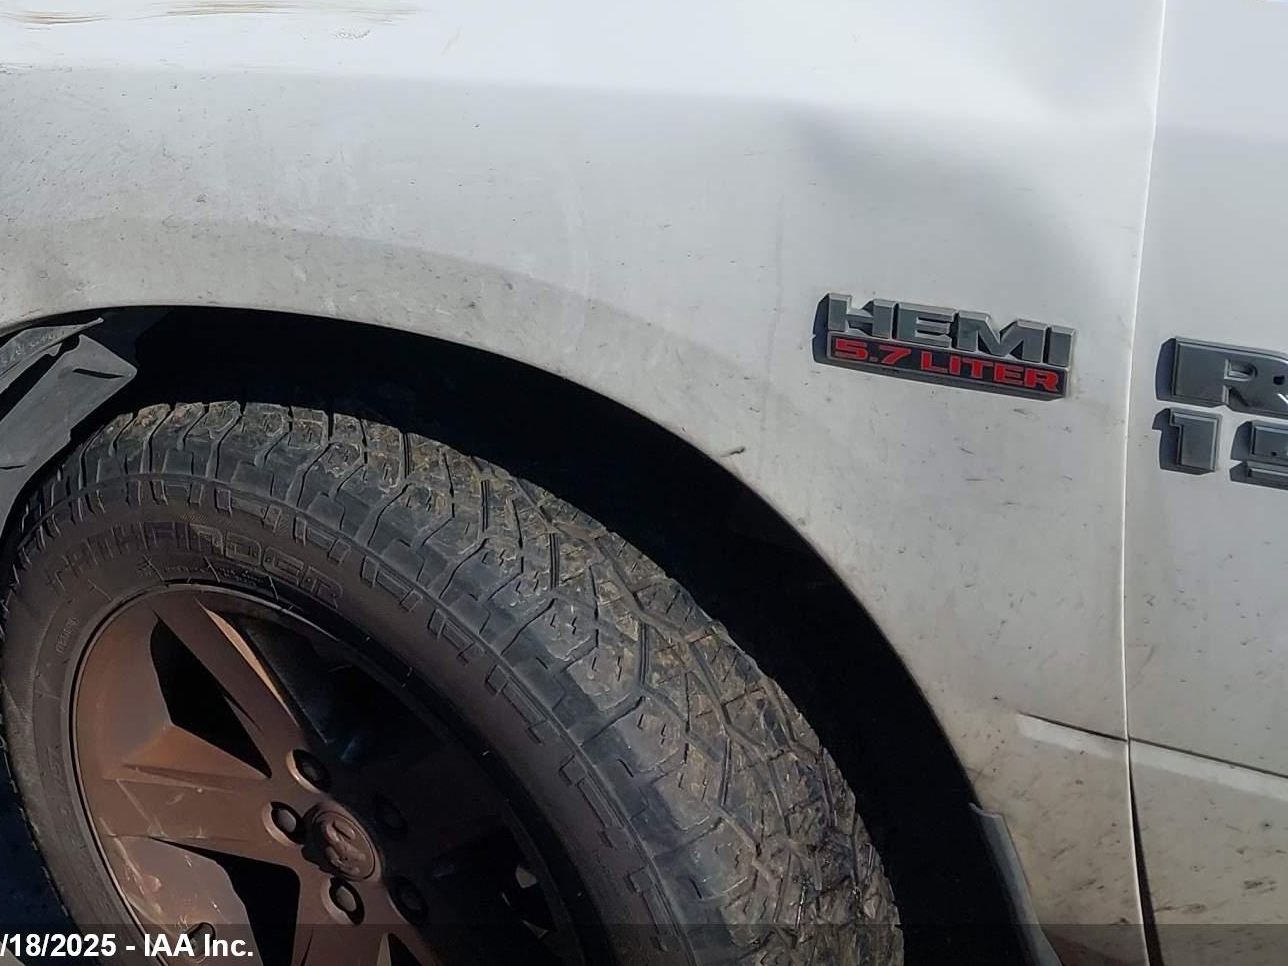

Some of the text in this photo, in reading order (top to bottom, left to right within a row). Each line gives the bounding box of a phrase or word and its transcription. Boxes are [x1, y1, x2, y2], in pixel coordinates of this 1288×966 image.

[824, 293, 1077, 368] HEMI
[835, 337, 1060, 392] 5.7 LITER
